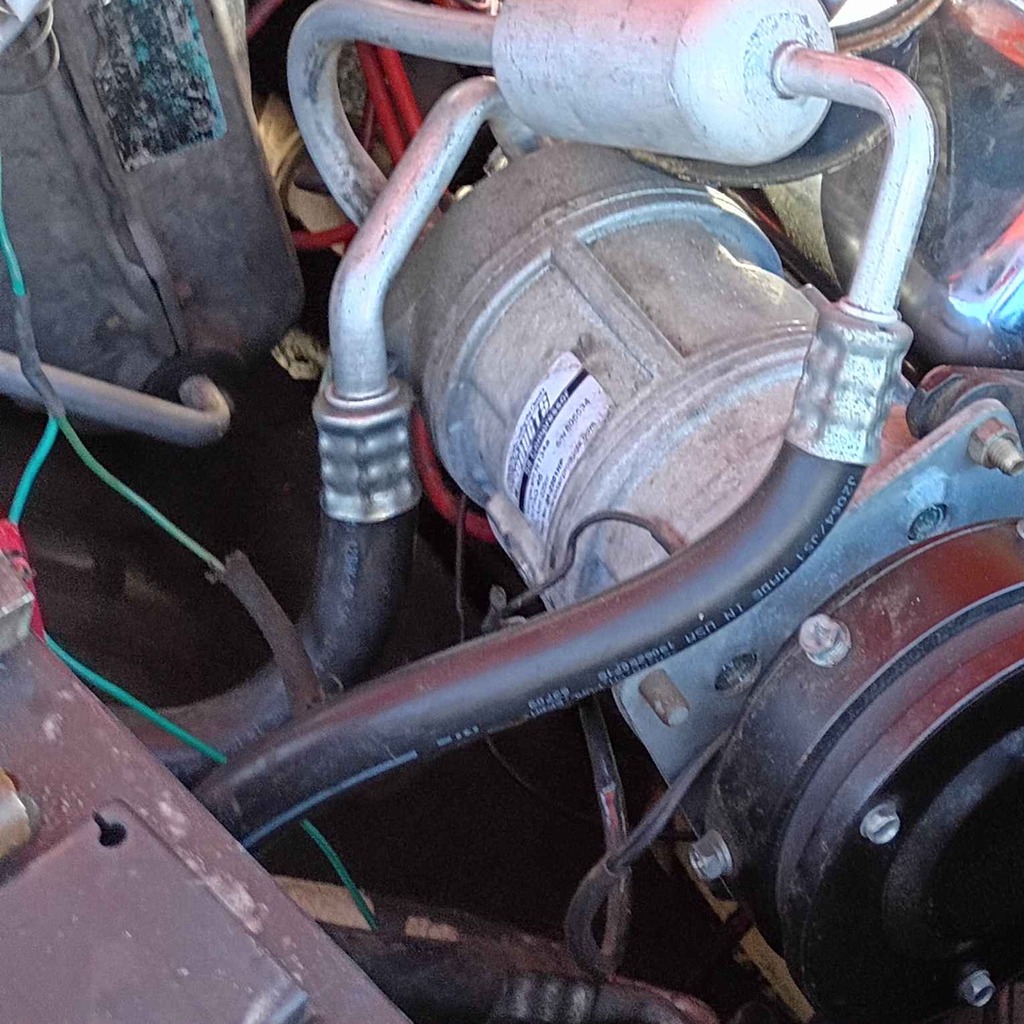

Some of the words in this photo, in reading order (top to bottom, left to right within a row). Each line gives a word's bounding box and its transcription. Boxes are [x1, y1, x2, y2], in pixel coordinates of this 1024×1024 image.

[753, 567, 789, 597] MADE
[724, 603, 743, 622] IN
[685, 621, 716, 644] USA
